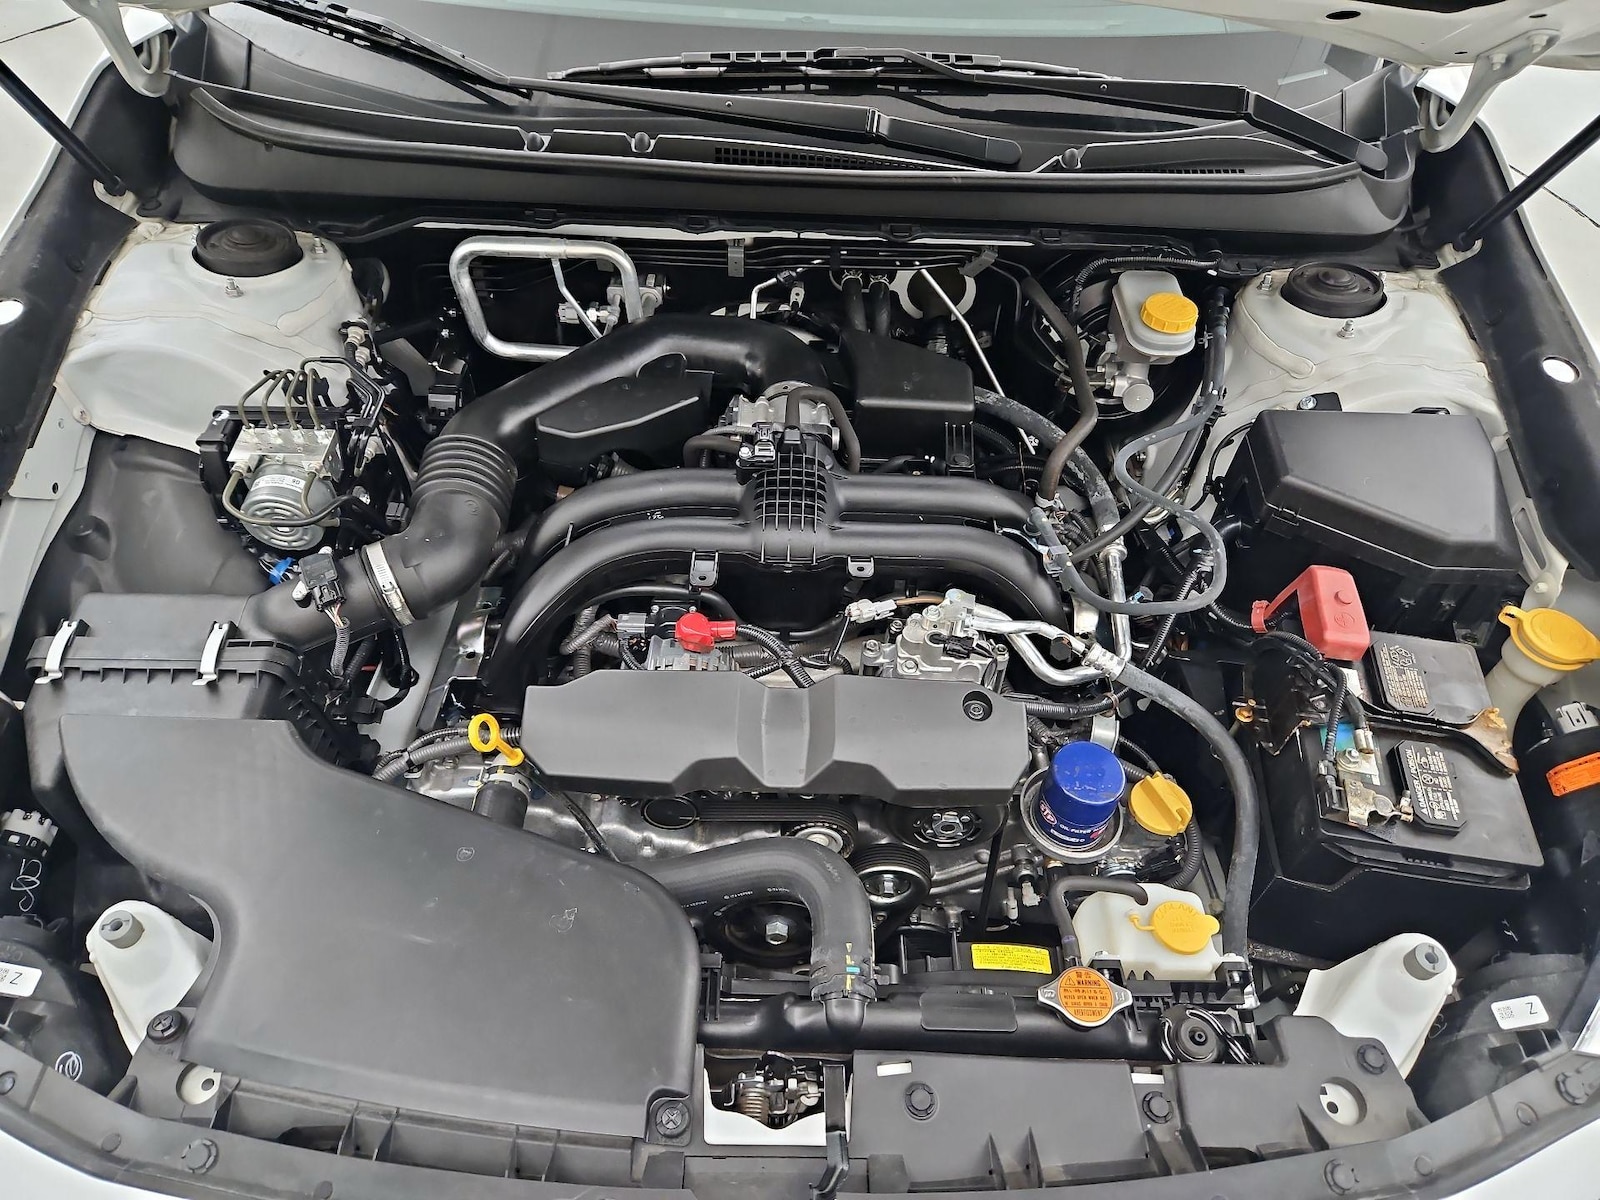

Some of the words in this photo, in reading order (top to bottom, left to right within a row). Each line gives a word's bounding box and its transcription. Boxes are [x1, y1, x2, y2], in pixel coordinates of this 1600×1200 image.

[1406, 749, 1417, 774] POISON
[1413, 779, 1427, 808] DANGER
[1040, 803, 1055, 822] STP
[9, 971, 23, 985] Z
[1525, 1001, 1538, 1015] Z
